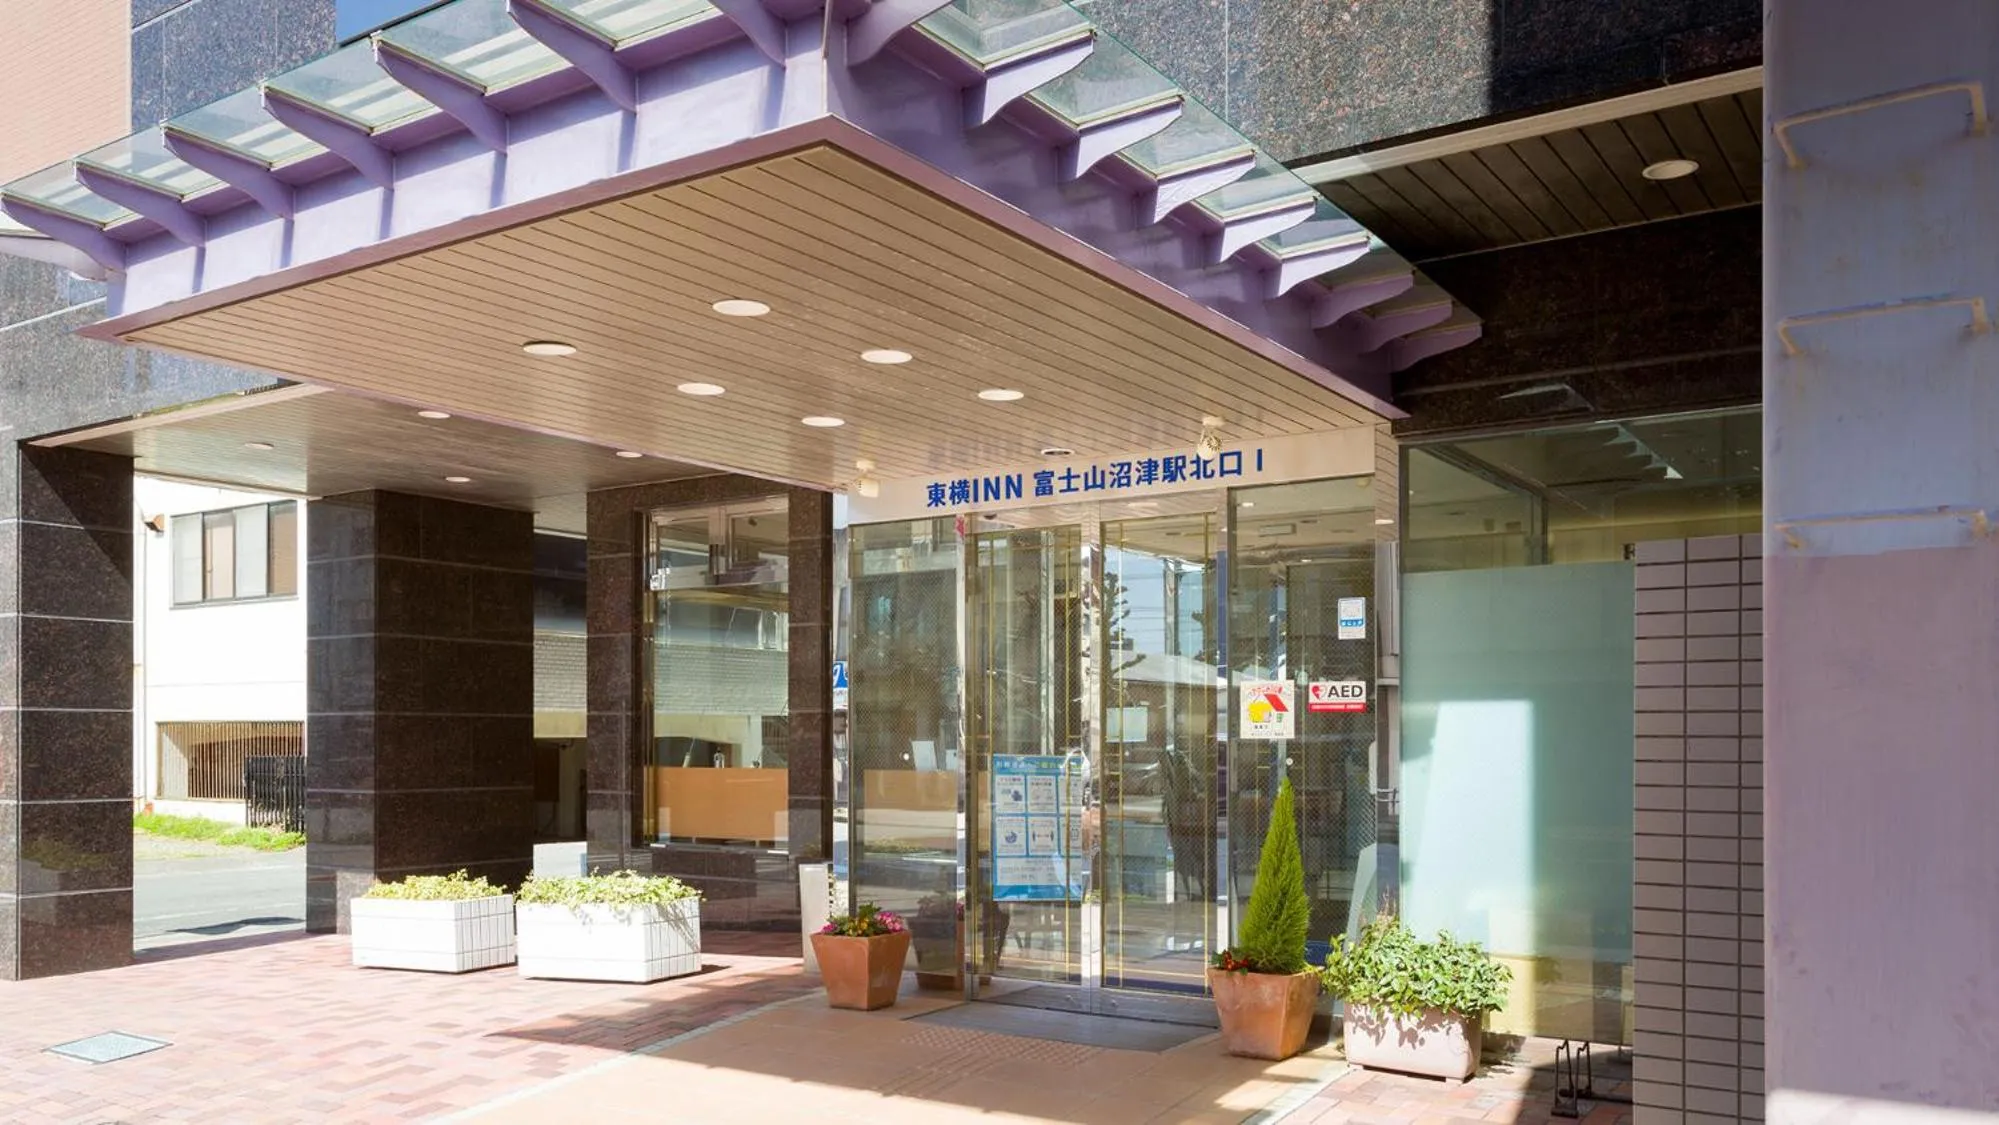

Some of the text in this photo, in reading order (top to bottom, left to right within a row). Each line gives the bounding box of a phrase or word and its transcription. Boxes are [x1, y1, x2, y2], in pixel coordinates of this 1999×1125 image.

[926, 473, 1023, 508] 東横INN
[1033, 450, 1242, 497] 富士山沼津駅北口
[1327, 685, 1363, 698] AED
